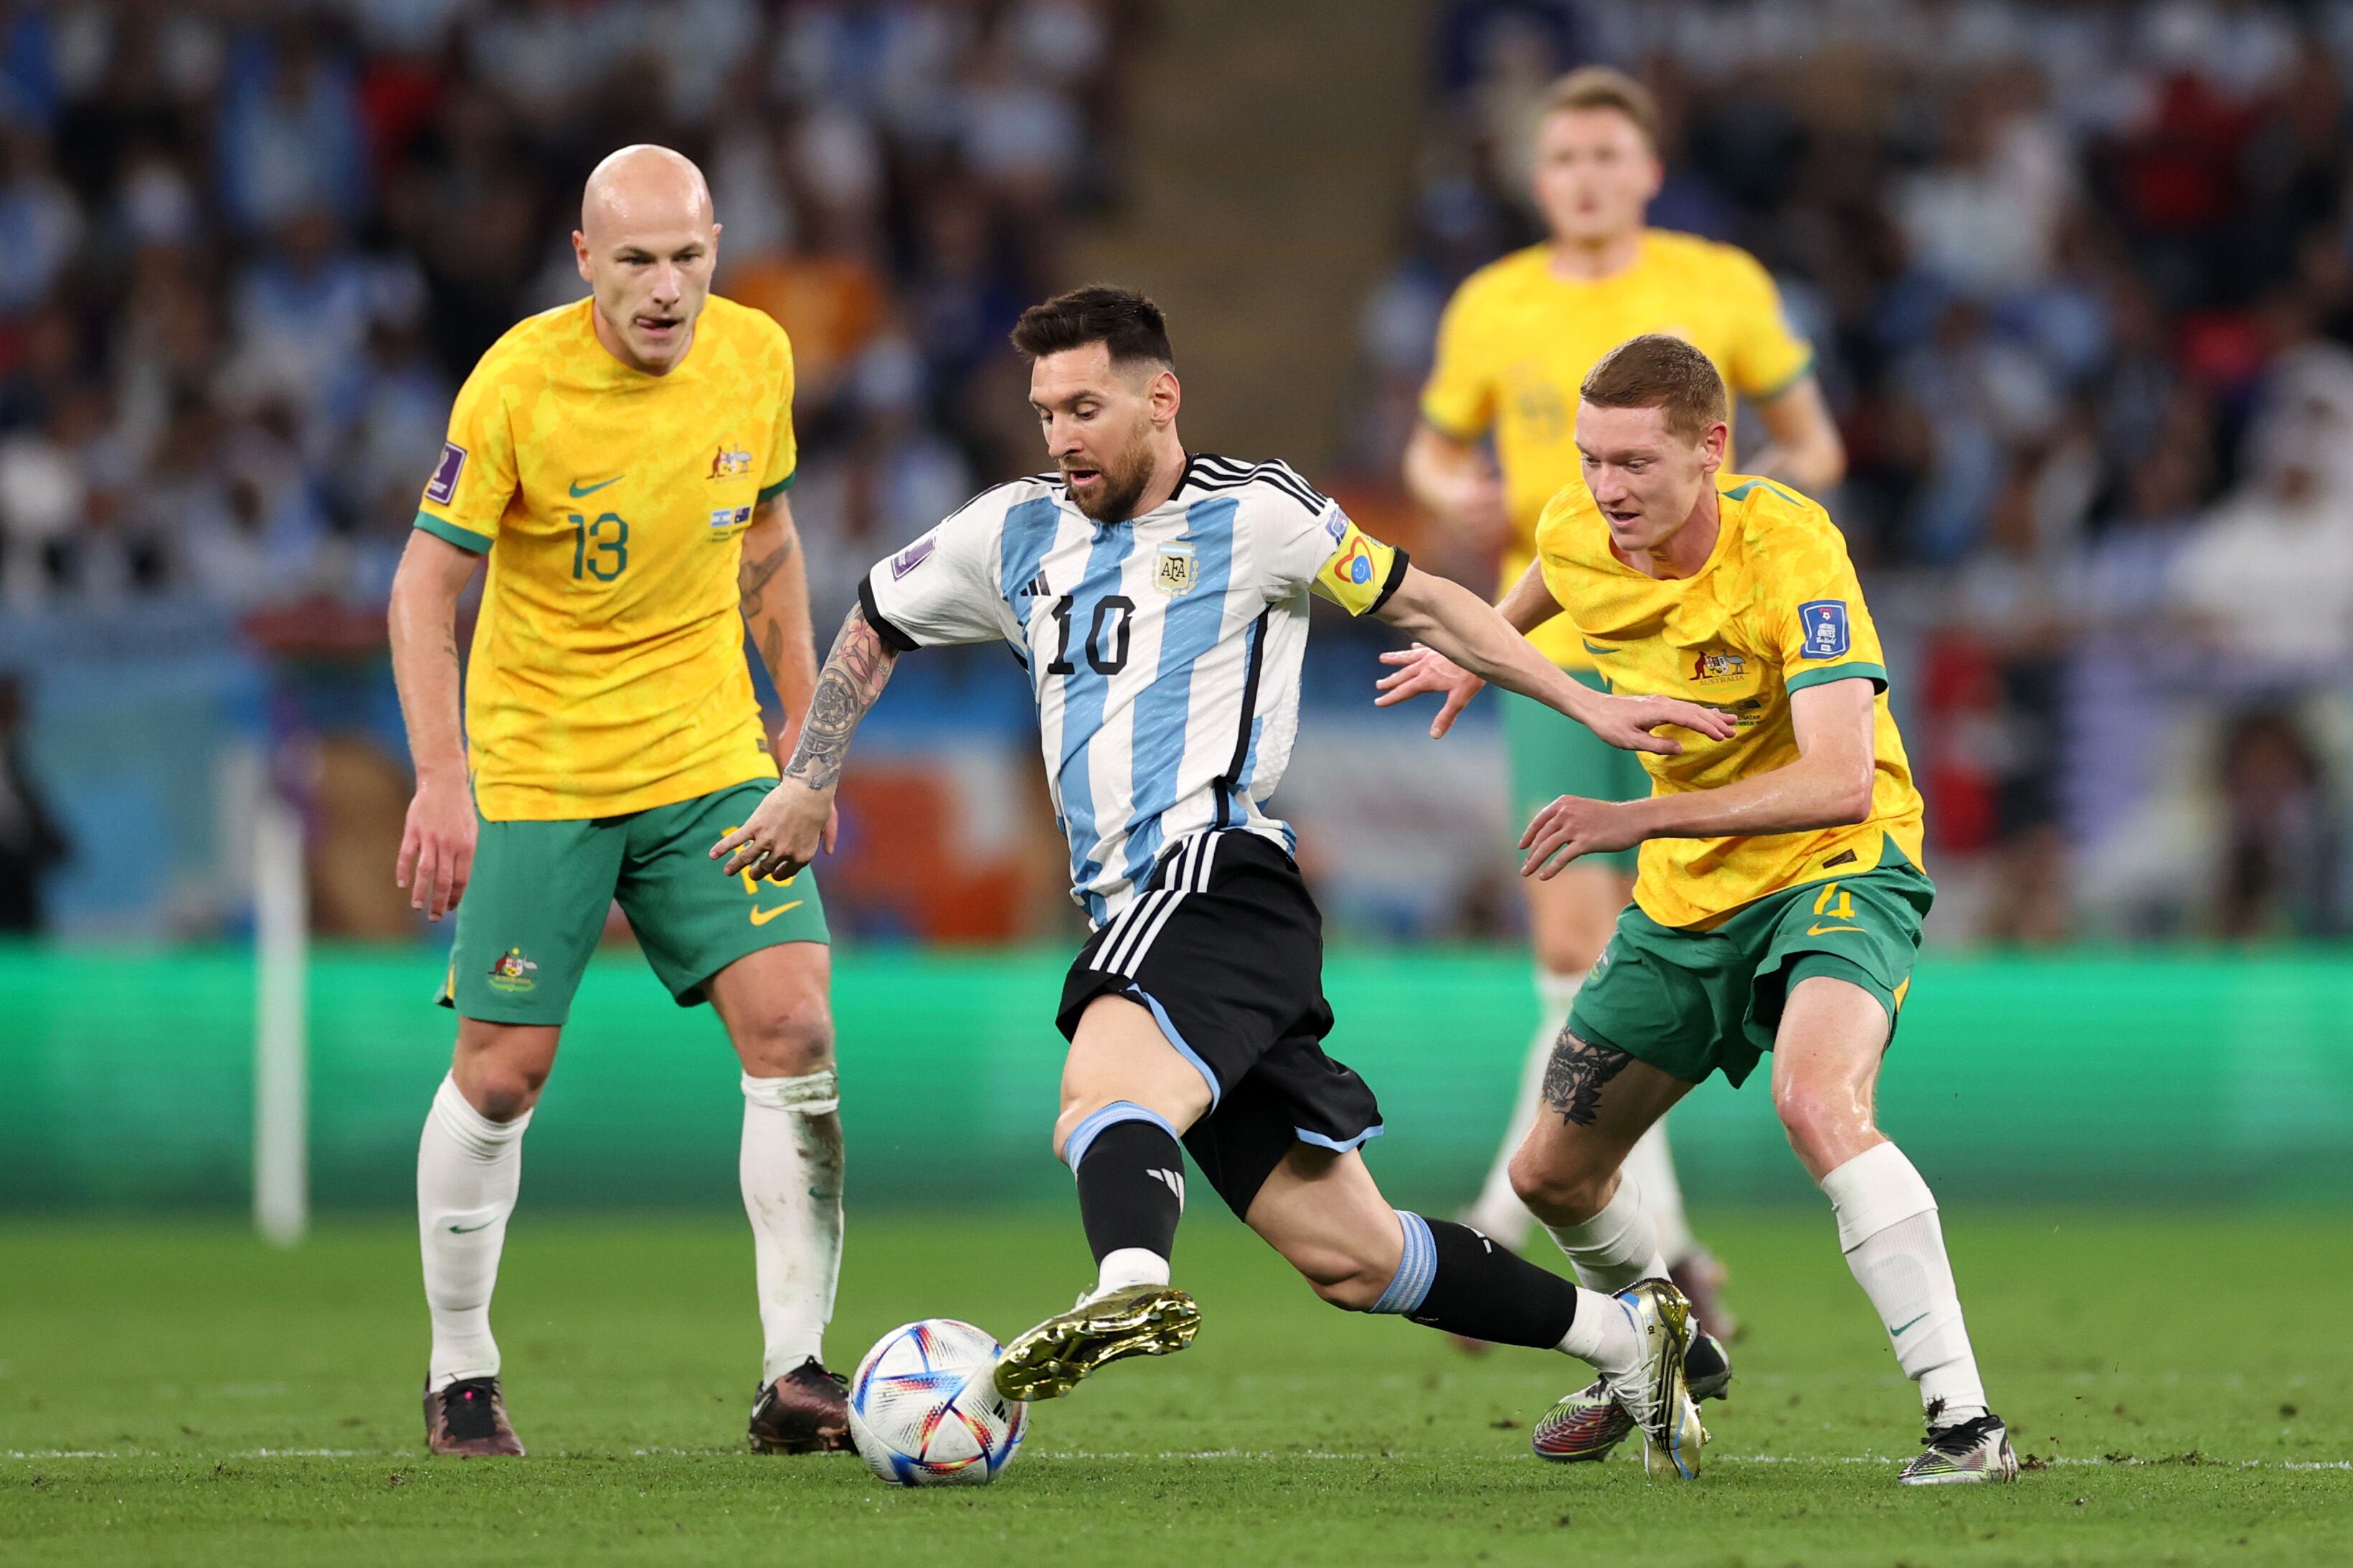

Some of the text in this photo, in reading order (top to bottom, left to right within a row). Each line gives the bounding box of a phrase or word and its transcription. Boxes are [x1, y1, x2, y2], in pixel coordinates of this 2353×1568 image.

[568, 513, 628, 581] 13
[1160, 556, 1186, 582] AFA
[1046, 594, 1137, 675] 10
[1699, 675, 1745, 686] AUSTRALIA
[1813, 882, 1856, 921] 4
